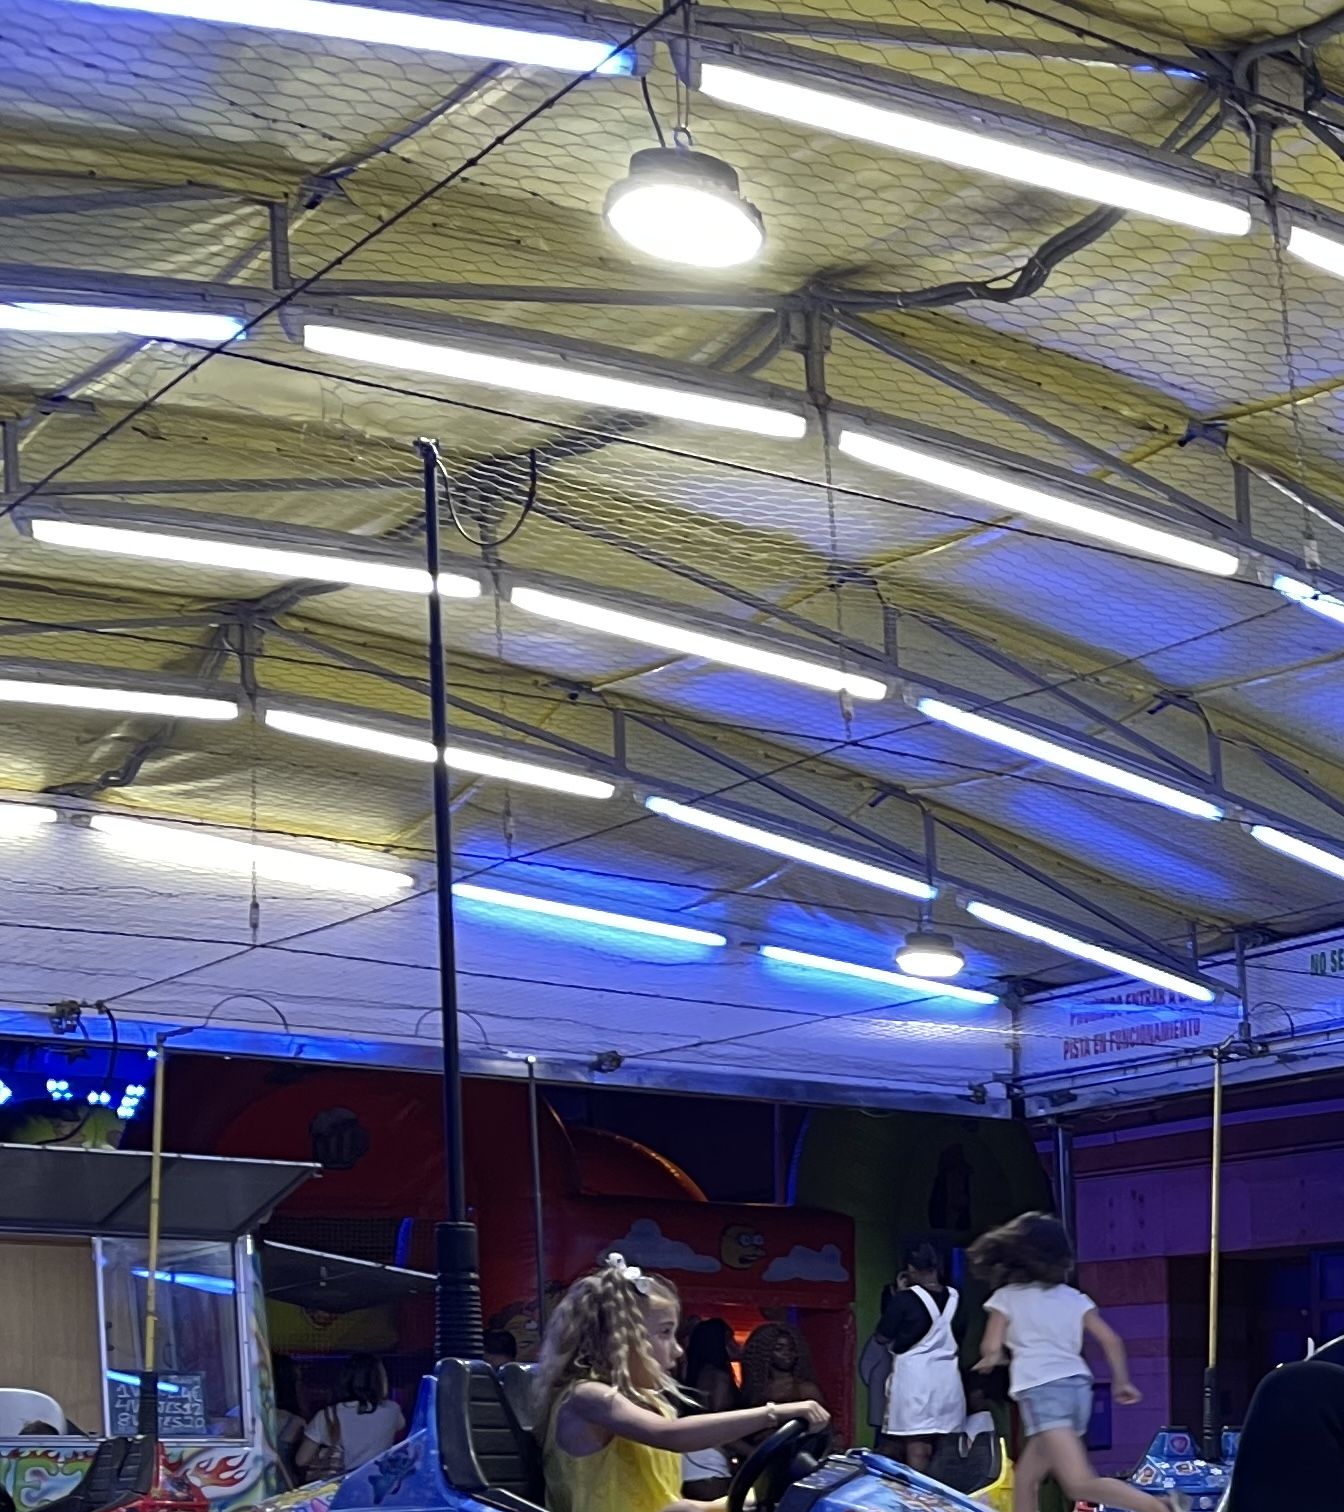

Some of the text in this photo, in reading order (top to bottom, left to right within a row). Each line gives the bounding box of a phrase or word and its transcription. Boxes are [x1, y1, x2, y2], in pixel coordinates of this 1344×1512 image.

[1310, 952, 1326, 975] NO
[1330, 948, 1344, 972] SE
[1063, 1035, 1092, 1060] PISTA
[1094, 1032, 1106, 1055] EN
